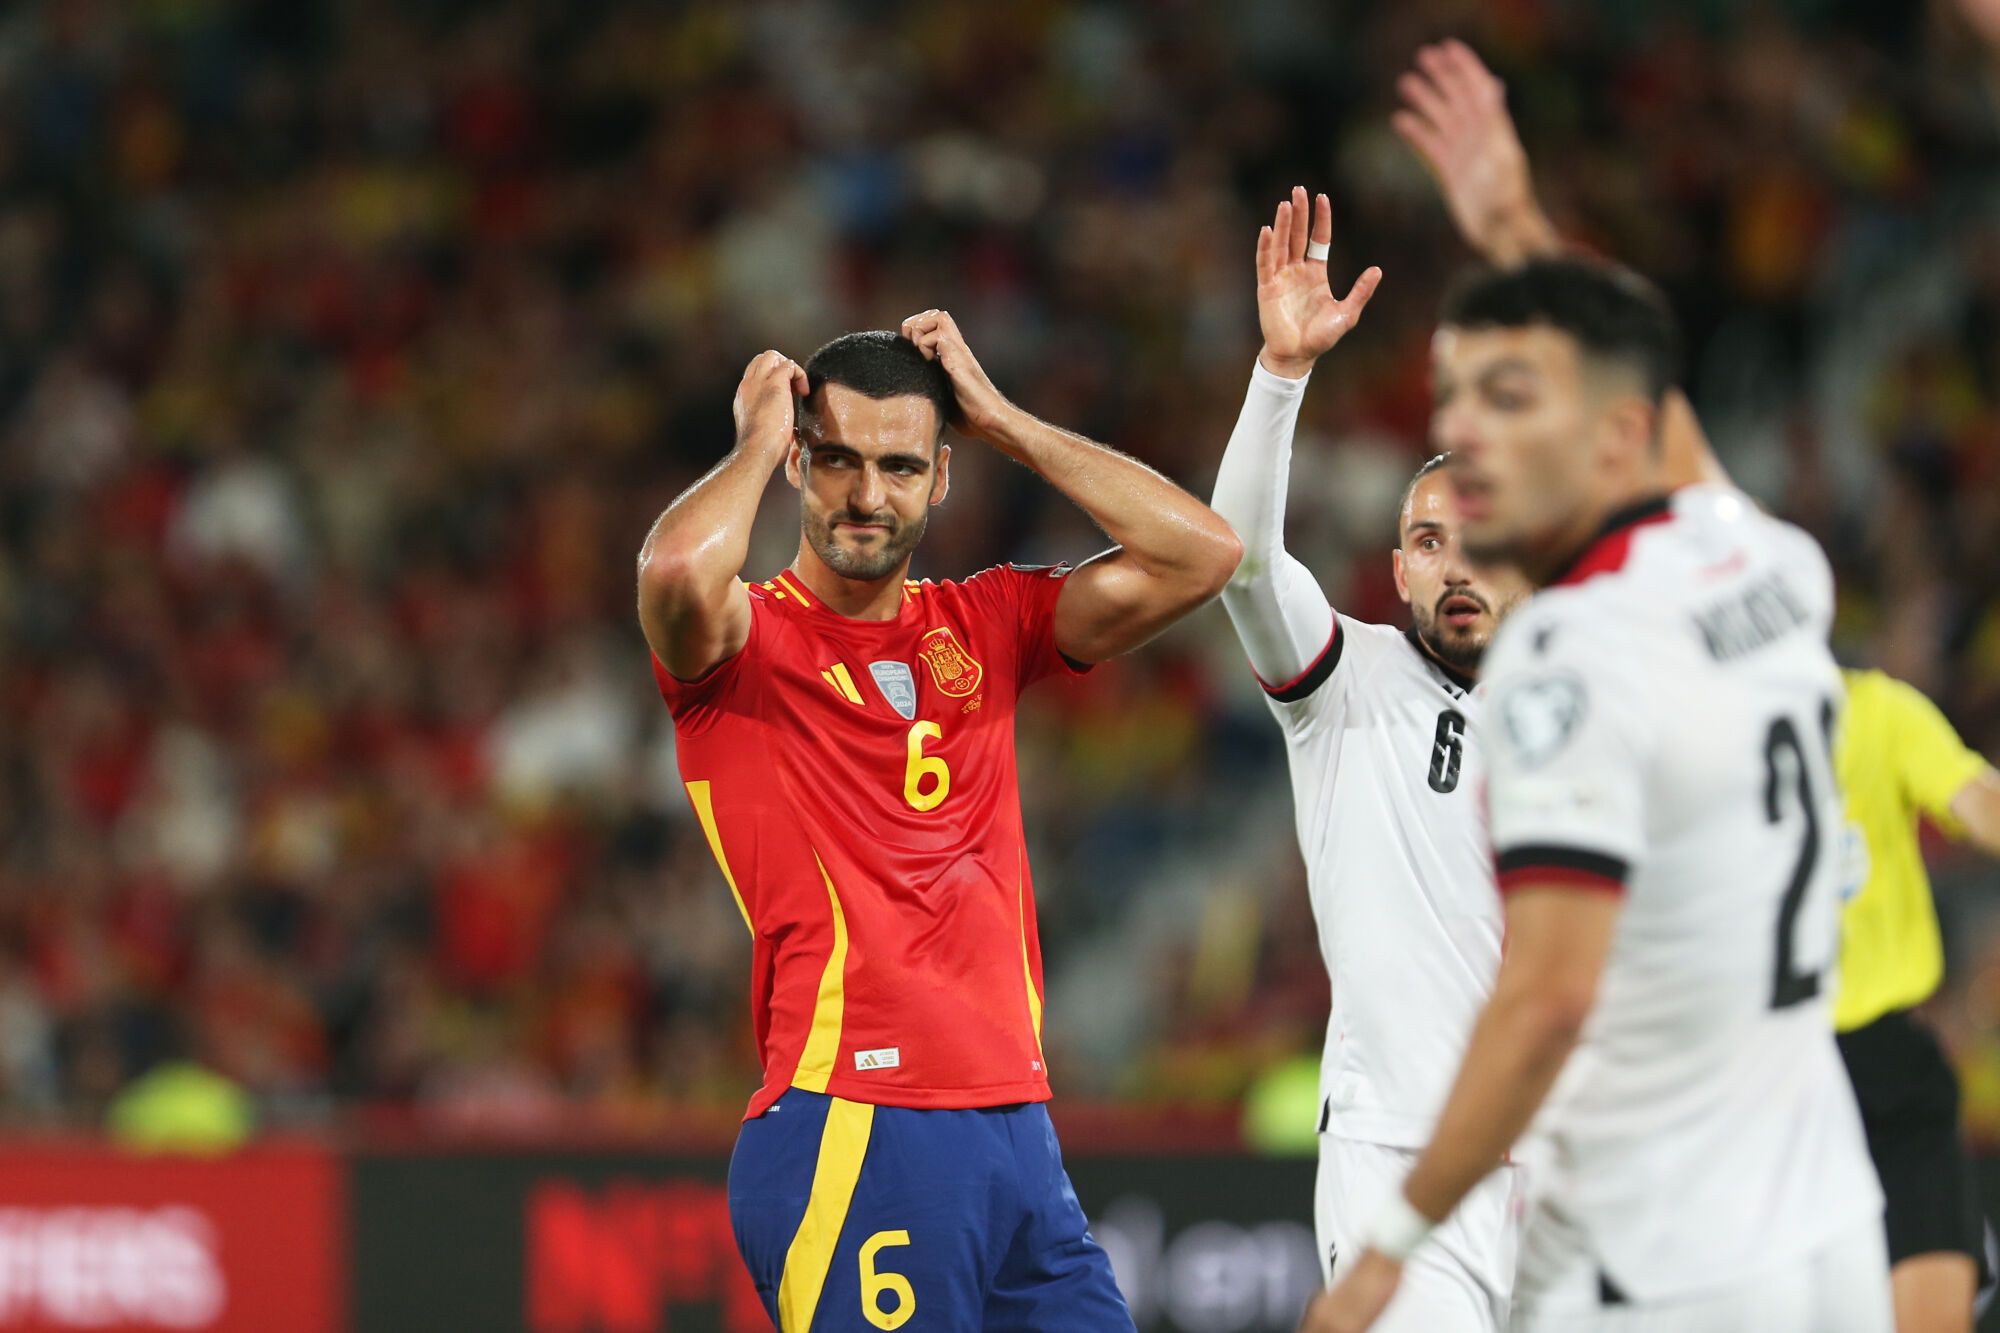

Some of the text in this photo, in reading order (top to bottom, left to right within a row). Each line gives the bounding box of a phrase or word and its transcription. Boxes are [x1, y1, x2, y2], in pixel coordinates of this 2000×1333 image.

[894, 701, 913, 709] 2024
[1427, 708, 1466, 794] 6
[904, 720, 950, 812] 6
[1765, 700, 1836, 1009] 2
[858, 1229, 917, 1332] 6
